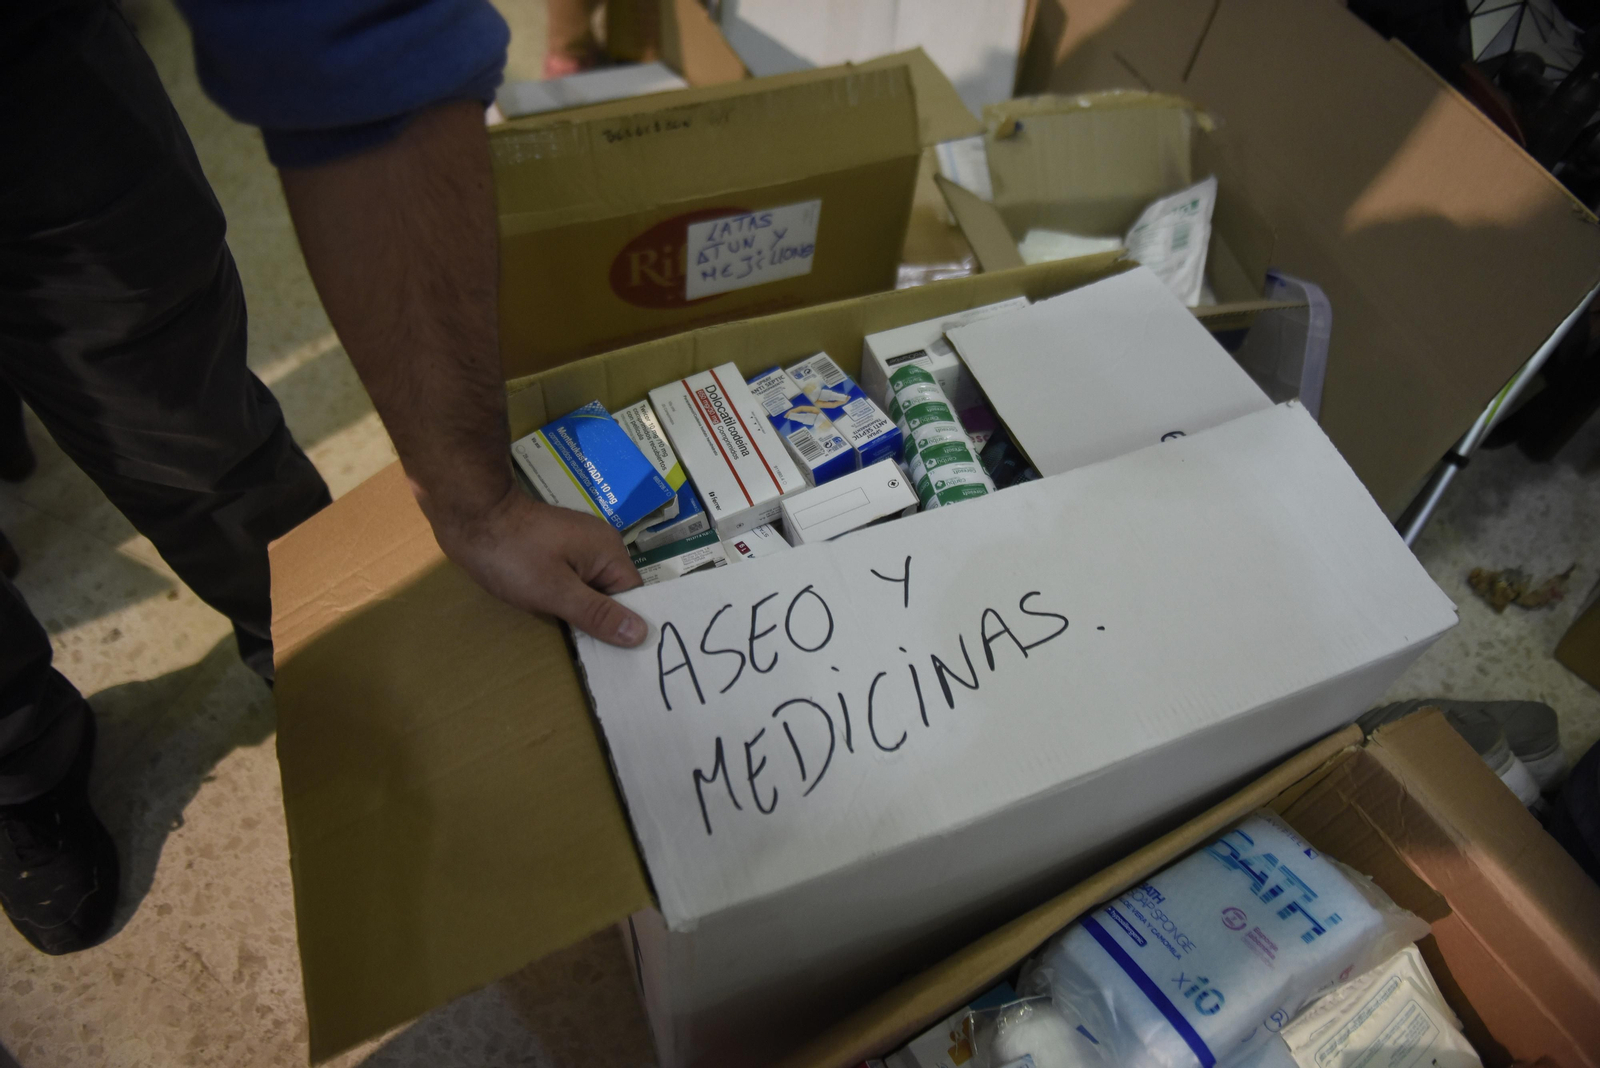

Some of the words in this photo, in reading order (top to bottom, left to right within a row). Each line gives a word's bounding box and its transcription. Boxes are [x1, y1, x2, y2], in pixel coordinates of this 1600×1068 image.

[707, 213, 773, 242] LATAS
[697, 235, 756, 266] ATUN
[771, 228, 789, 249] Y
[750, 384, 764, 394] ANTI
[765, 374, 784, 387] SEPTIC
[756, 376, 771, 386] SPRAY
[626, 410, 634, 420] con
[872, 419, 887, 429] ANTI
[631, 407, 652, 440] comprimidos
[648, 440, 667, 470] recubiertos
[716, 425, 739, 460] Comprimidos
[851, 426, 873, 440] SEPTIC
[866, 428, 882, 439] SPRAY
[556, 425, 588, 462] Montelukast
[584, 460, 604, 484] STADA
[599, 482, 610, 493] 10
[605, 490, 618, 505] mg
[660, 447, 668, 457] mg
[547, 430, 573, 461] comprimidos
[569, 459, 592, 487] recubiertos
[588, 485, 599, 497] con
[610, 513, 624, 528] EFG
[710, 496, 722, 511] ferrer
[634, 556, 646, 564] nfa
[657, 585, 834, 711] ASEO
[870, 555, 912, 608] Y
[1201, 828, 1343, 944] BATH
[1109, 909, 1144, 945] hypoallergenic
[1131, 907, 1147, 924] VERA
[1150, 927, 1182, 960] CAMOMILA
[1149, 907, 1196, 954] SPONGE
